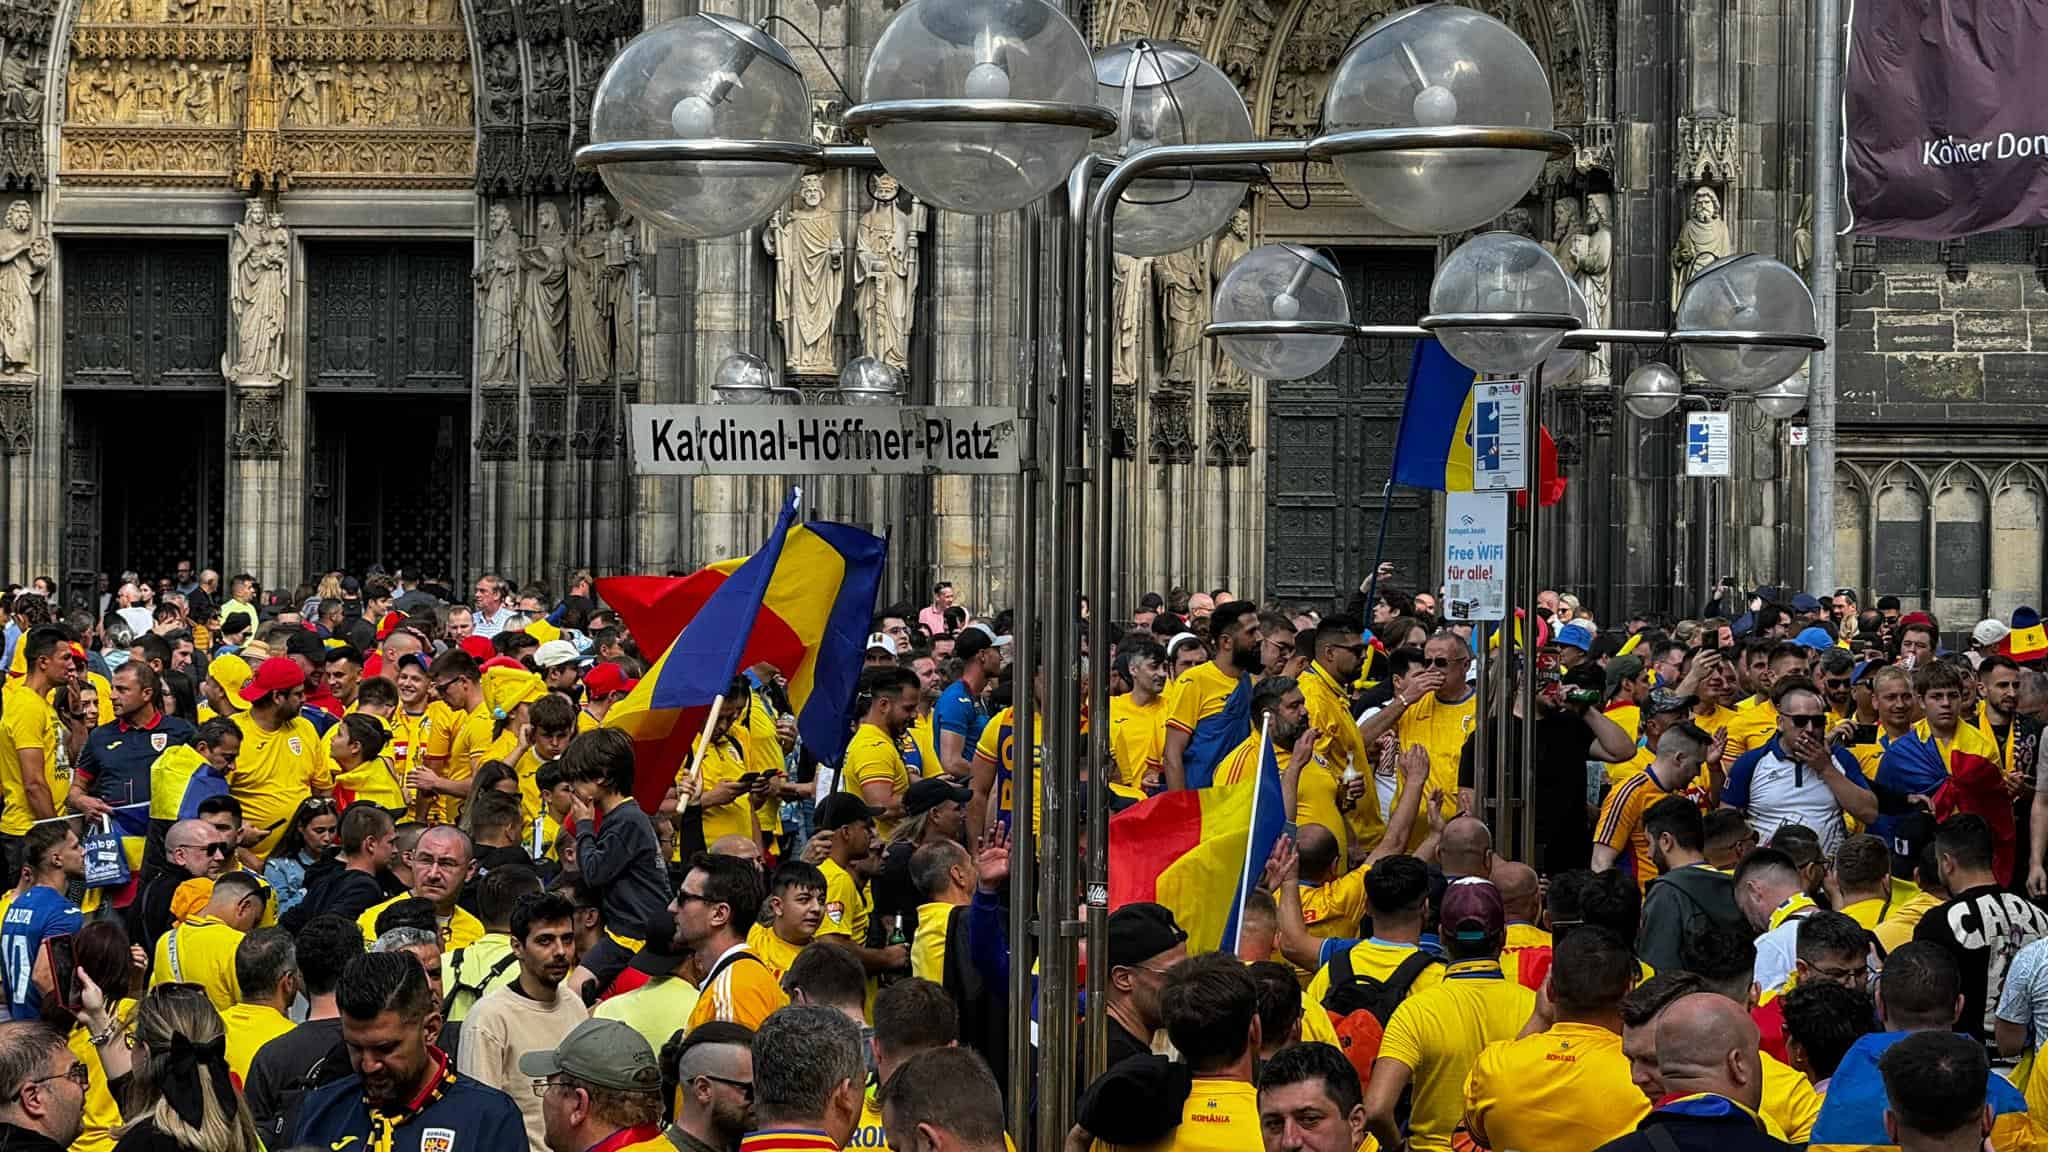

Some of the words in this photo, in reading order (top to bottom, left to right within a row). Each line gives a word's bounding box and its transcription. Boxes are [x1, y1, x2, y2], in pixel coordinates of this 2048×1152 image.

[651, 417, 999, 462] Kardinal-Höffner-Platz
[1448, 545, 1474, 560] Free
[1477, 544, 1503, 560] WiFi
[1448, 565, 1464, 580] für
[1467, 564, 1492, 580] alle!
[105, 840, 115, 849] go
